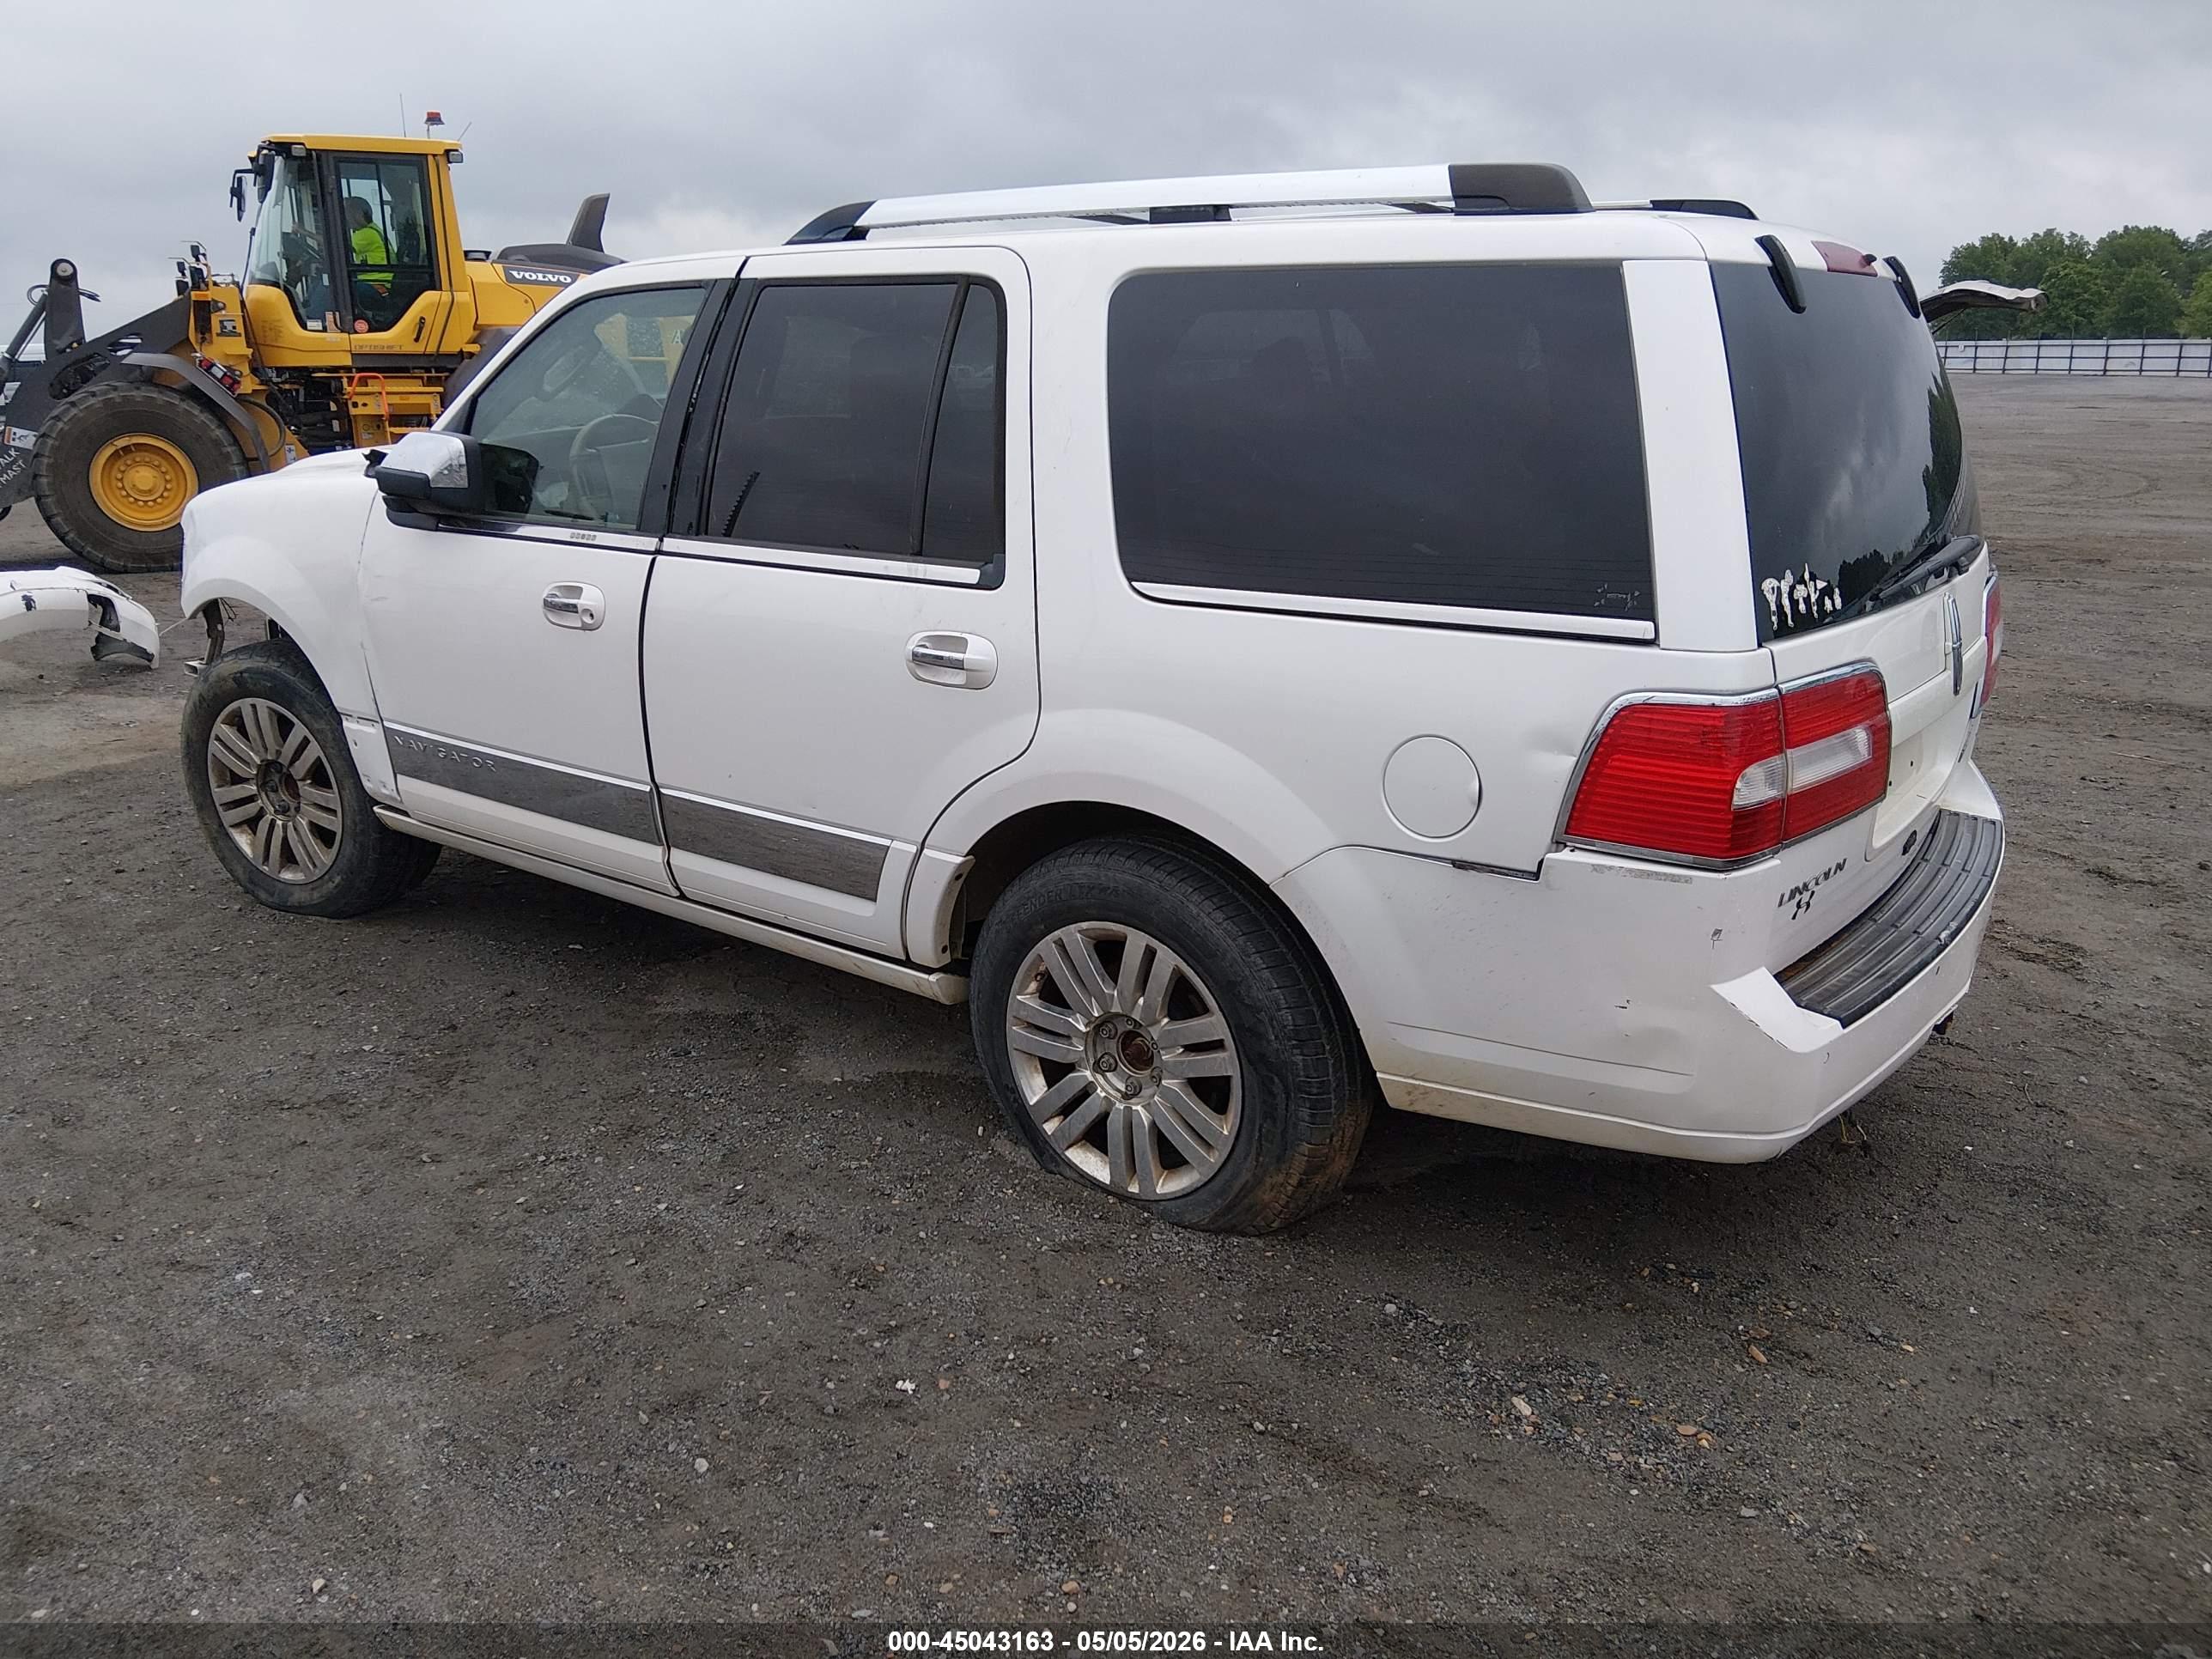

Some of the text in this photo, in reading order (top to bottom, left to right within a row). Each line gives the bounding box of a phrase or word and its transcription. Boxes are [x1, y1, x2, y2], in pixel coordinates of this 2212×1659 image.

[509, 270, 572, 283] VOLVO
[0, 447, 21, 470] ALK
[393, 734, 497, 772] NAVIGATOR
[1777, 857, 1848, 908] LINCOLN
